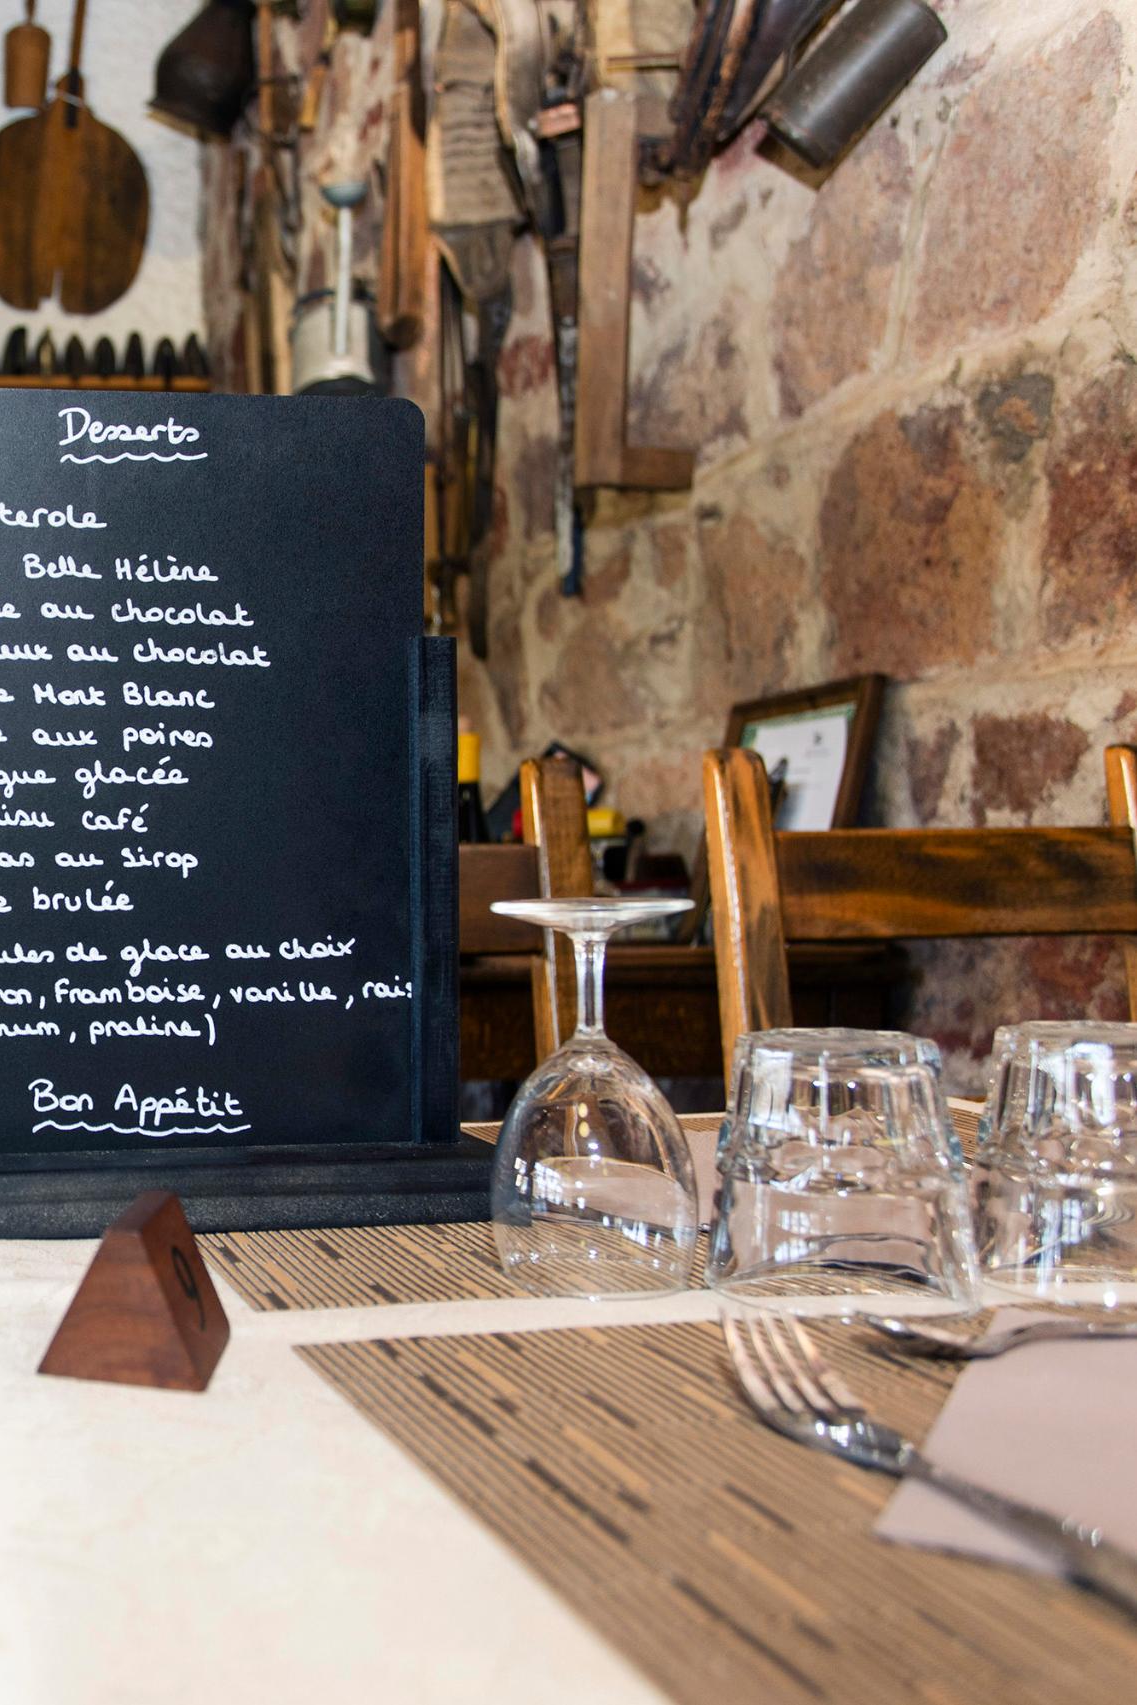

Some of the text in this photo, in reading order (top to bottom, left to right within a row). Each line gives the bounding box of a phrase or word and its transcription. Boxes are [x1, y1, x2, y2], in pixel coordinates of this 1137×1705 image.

[57, 406, 200, 446] Desserts
[22, 552, 103, 580] Belle
[115, 553, 219, 583] Hélène
[40, 602, 95, 620] au
[111, 598, 255, 627] chocolat
[66, 643, 119, 663] au
[133, 637, 271, 668] chocolat
[32, 682, 107, 706] Mont
[122, 681, 216, 709] Blanc
[31, 728, 98, 747] aux
[122, 722, 214, 751] poires
[74, 755, 189, 800] glacée
[81, 803, 149, 833] café
[54, 852, 104, 868] au
[32, 879, 134, 912] brulée
[65, 941, 108, 962] de
[120, 938, 210, 978] glace
[225, 943, 271, 959] au
[278, 934, 356, 960] choix
[27, 1078, 244, 1126] Bon Appétit
[170, 1246, 206, 1332] 9
